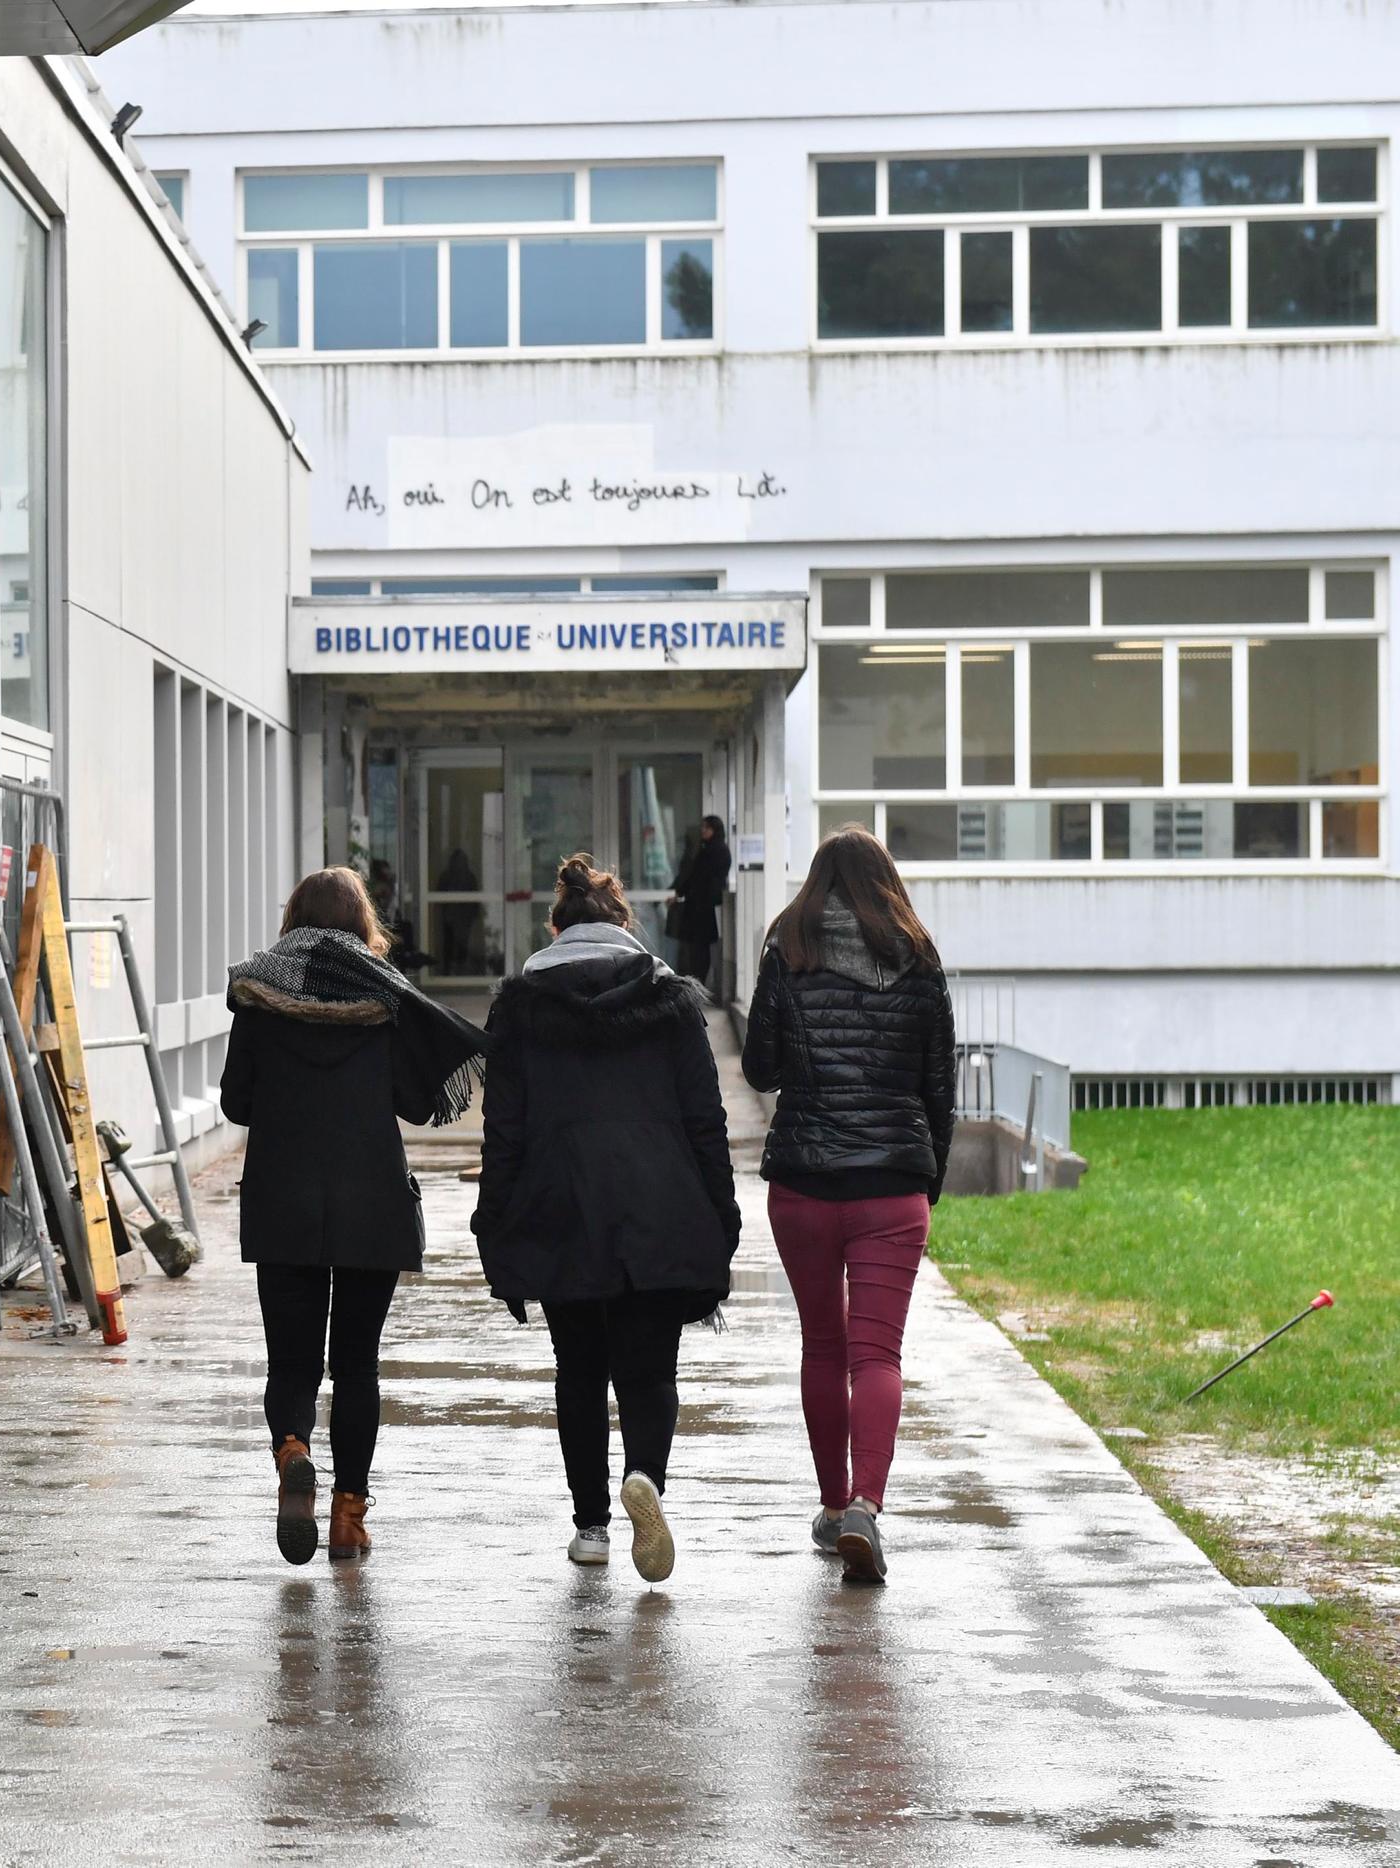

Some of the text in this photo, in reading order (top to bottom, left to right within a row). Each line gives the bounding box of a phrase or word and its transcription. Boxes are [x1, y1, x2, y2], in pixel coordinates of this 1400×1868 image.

[346, 484, 386, 516] Ah,
[403, 482, 445, 507] oui.
[471, 479, 513, 510] On
[532, 477, 572, 506] est
[588, 476, 711, 512] toujours
[315, 620, 787, 653] BIBLIOTHEQUE UNIVERSITAIRE
